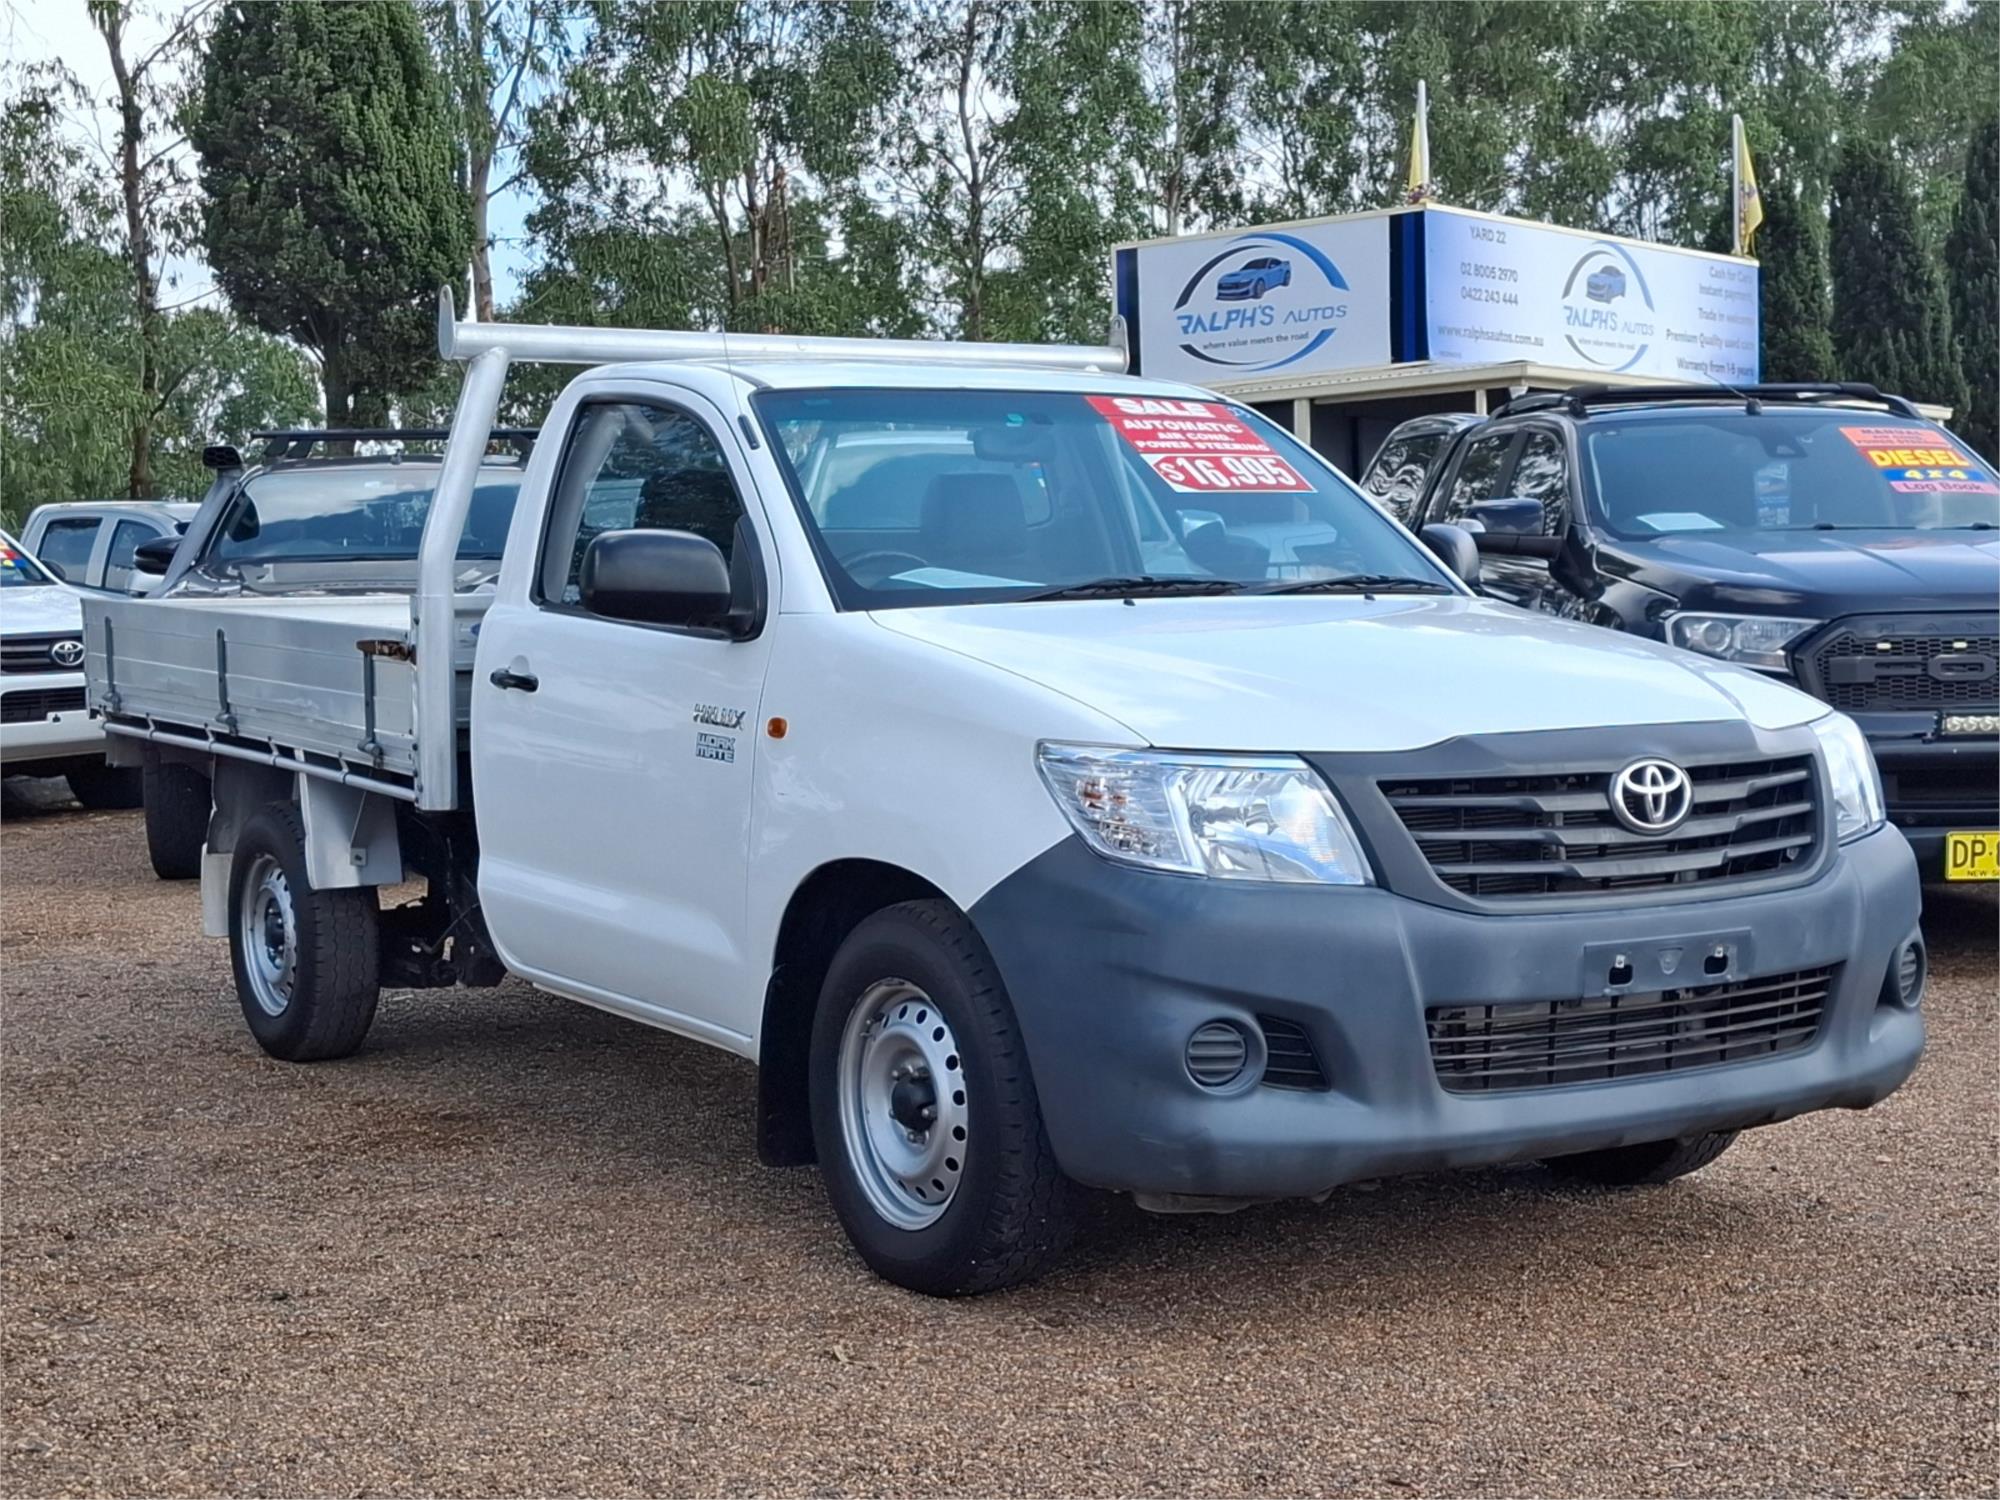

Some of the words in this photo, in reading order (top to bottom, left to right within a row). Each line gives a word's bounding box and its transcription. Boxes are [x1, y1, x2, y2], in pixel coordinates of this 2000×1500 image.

[1469, 225, 1494, 242] YARD
[1496, 229, 1506, 244] 22
[1461, 262, 1472, 276] 02
[1474, 264, 1497, 280] 8005
[1498, 267, 1518, 283] 2970
[1461, 285, 1483, 301] 0422
[1484, 288, 1500, 304] 243
[1502, 291, 1518, 306] 444
[1176, 305, 1274, 335] RALPH'S
[1283, 305, 1348, 324] AUTOS
[1202, 341, 1226, 350] where
[1228, 338, 1248, 348] value
[1250, 336, 1273, 345] meets
[1276, 333, 1289, 342] the
[1291, 331, 1310, 341] road
[1437, 325, 1544, 347] www.ralphsautos.com.au
[1112, 398, 1217, 418] SALE
[1123, 418, 1243, 434] AUTOMATIC
[1135, 440, 1193, 449] POWER
[1195, 441, 1271, 452] STEERING
[1156, 432, 1184, 441] AIR
[1867, 449, 1970, 467] DIESEL
[1158, 457, 1297, 488] $16,995
[1903, 482, 1937, 491] Log
[1943, 482, 1982, 491] Book
[697, 732, 736, 752] WORK
[696, 744, 735, 763] MATE
